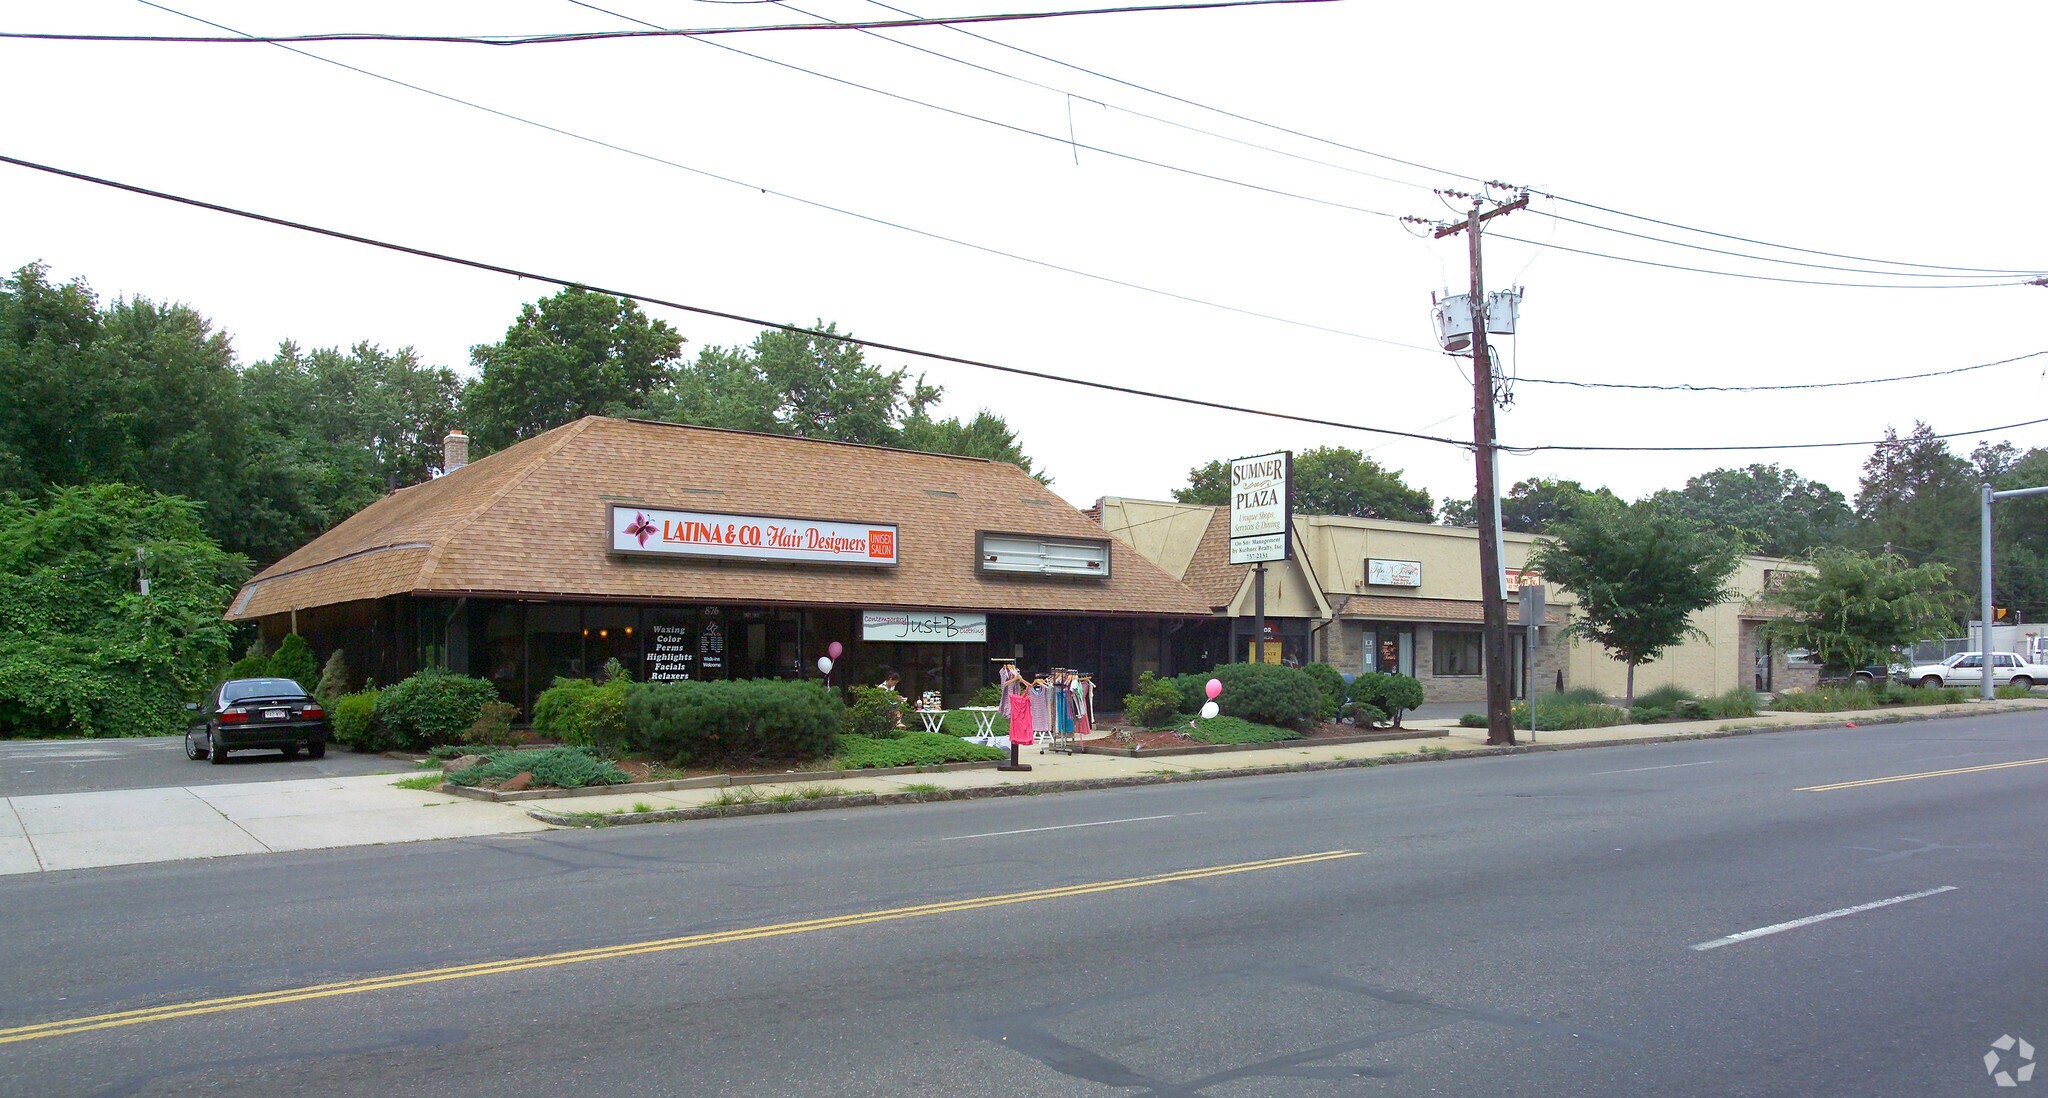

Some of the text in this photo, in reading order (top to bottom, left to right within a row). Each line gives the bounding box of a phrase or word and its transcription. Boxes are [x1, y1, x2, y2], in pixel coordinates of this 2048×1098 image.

[1233, 459, 1283, 486] SUMNER
[1236, 489, 1279, 510] PLAZA
[663, 520, 866, 554] LATINA & CO. Hair Designers
[870, 532, 893, 544] UNISEX
[1252, 537, 1281, 545] Management
[871, 544, 892, 555] SALON
[704, 606, 720, 616] 876
[653, 625, 686, 635] Waxing
[657, 635, 682, 643] Color
[656, 643, 684, 652] Perms
[646, 652, 693, 663] Highlights
[654, 662, 686, 671] Facials
[651, 672, 690, 680] Relaxers
